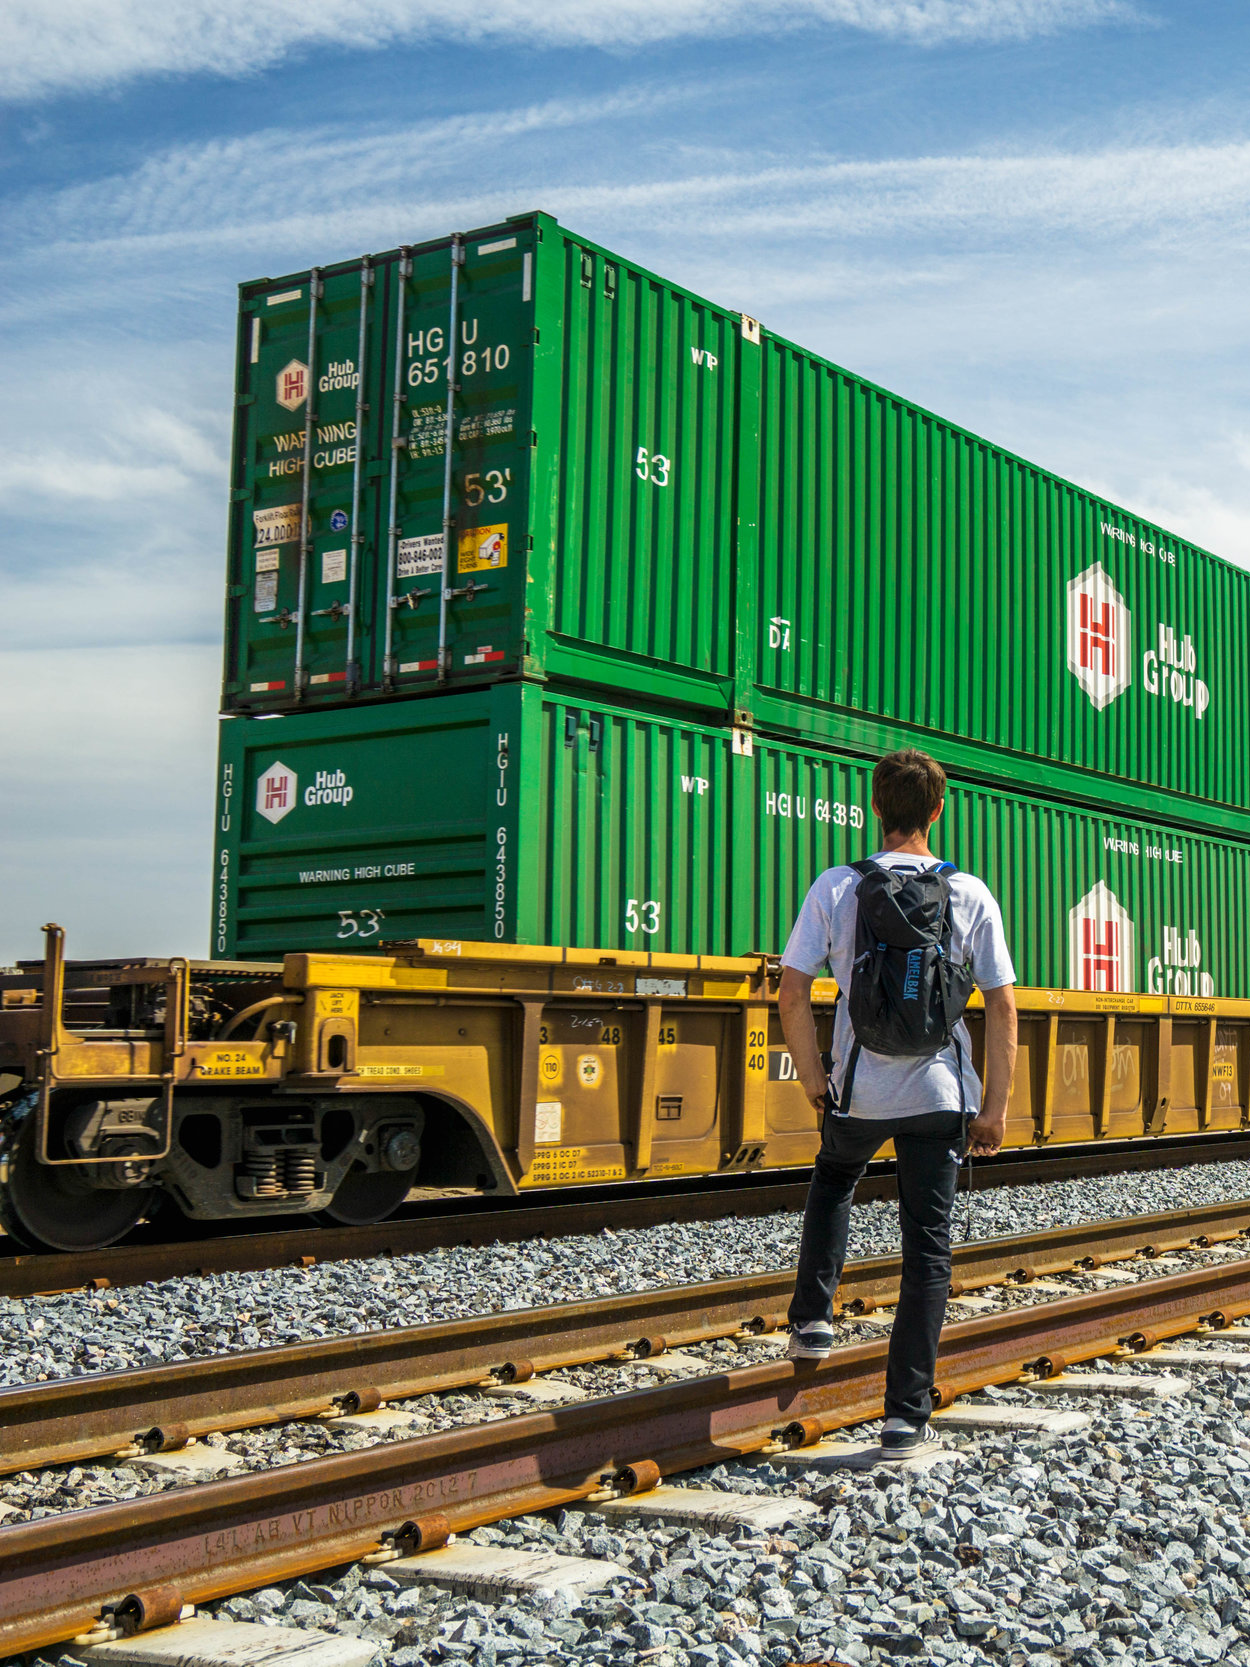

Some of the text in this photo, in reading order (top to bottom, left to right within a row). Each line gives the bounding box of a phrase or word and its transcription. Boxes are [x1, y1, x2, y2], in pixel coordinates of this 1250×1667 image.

[408, 318, 478, 358] HGU
[328, 359, 354, 378] Hub
[318, 372, 360, 393] Group
[314, 446, 357, 469] CUBE
[464, 468, 511, 507] 53'
[398, 546, 443, 566] 800-846-002
[1158, 622, 1197, 674] Hub
[1143, 650, 1210, 720] Group
[316, 769, 347, 790] Hub
[497, 732, 509, 807] HGIU
[221, 763, 234, 832] HGIU
[304, 785, 353, 807] Group
[299, 863, 415, 883] WARNING HIGH CUBE
[495, 827, 508, 939] 643850
[217, 849, 229, 953] 643850
[336, 908, 386, 939] 53'
[1163, 925, 1201, 969] Hub
[903, 948, 923, 1001] CAMELBAK
[1175, 1001, 1216, 1012] DTTX 655646
[601, 1027, 620, 1045] 48
[658, 1028, 676, 1045] 45
[748, 1031, 765, 1047] 20
[216, 1053, 246, 1063] NO. 24
[545, 1062, 558, 1073] 110
[748, 1054, 765, 1070] 40
[236, 1066, 260, 1075] BEAM
[533, 1151, 551, 1160] SPRG
[533, 1162, 551, 1171] SPRG
[533, 1174, 551, 1182] SPRG
[327, 1492, 405, 1528] NIPPON
[413, 1475, 459, 1503] 2012
